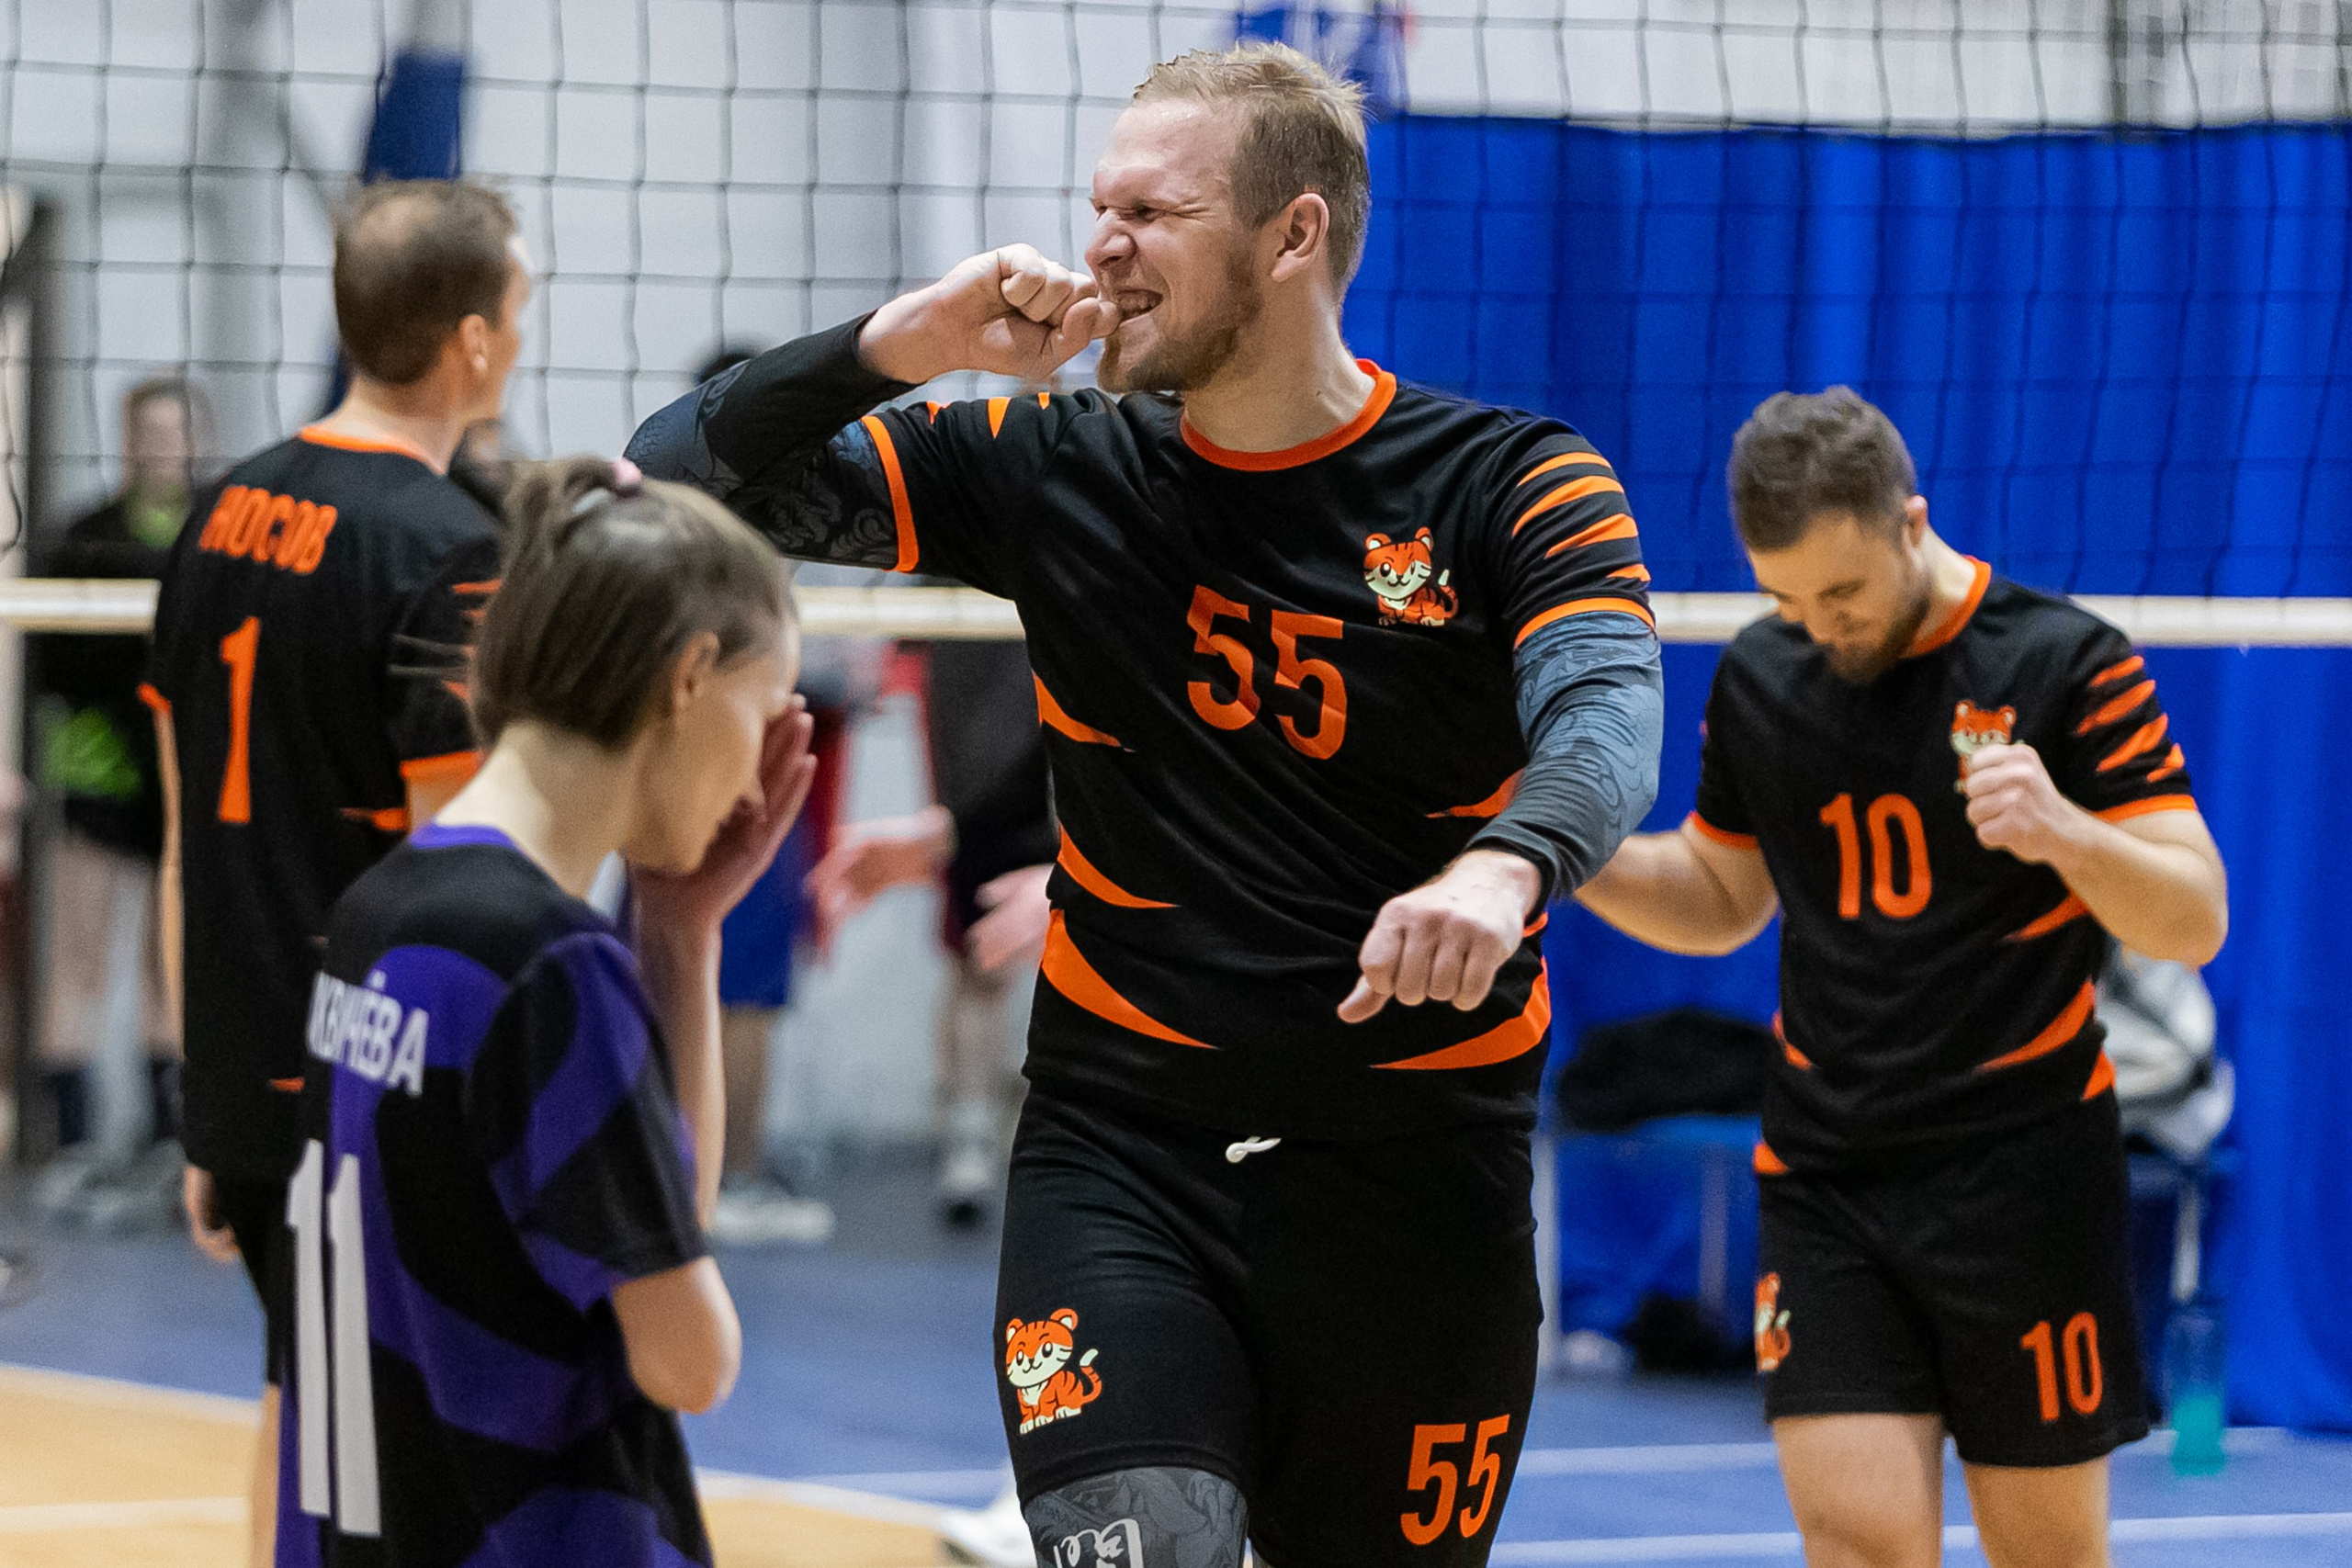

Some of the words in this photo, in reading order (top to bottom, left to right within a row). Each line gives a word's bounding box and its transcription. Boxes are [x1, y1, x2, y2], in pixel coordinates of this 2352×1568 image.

[218, 616, 259, 824] 1
[1186, 585, 1348, 760] 55
[1820, 794, 1932, 919] 10
[287, 1139, 380, 1535] 11
[2021, 1312, 2103, 1421] 10
[1400, 1414, 1510, 1546] 55
